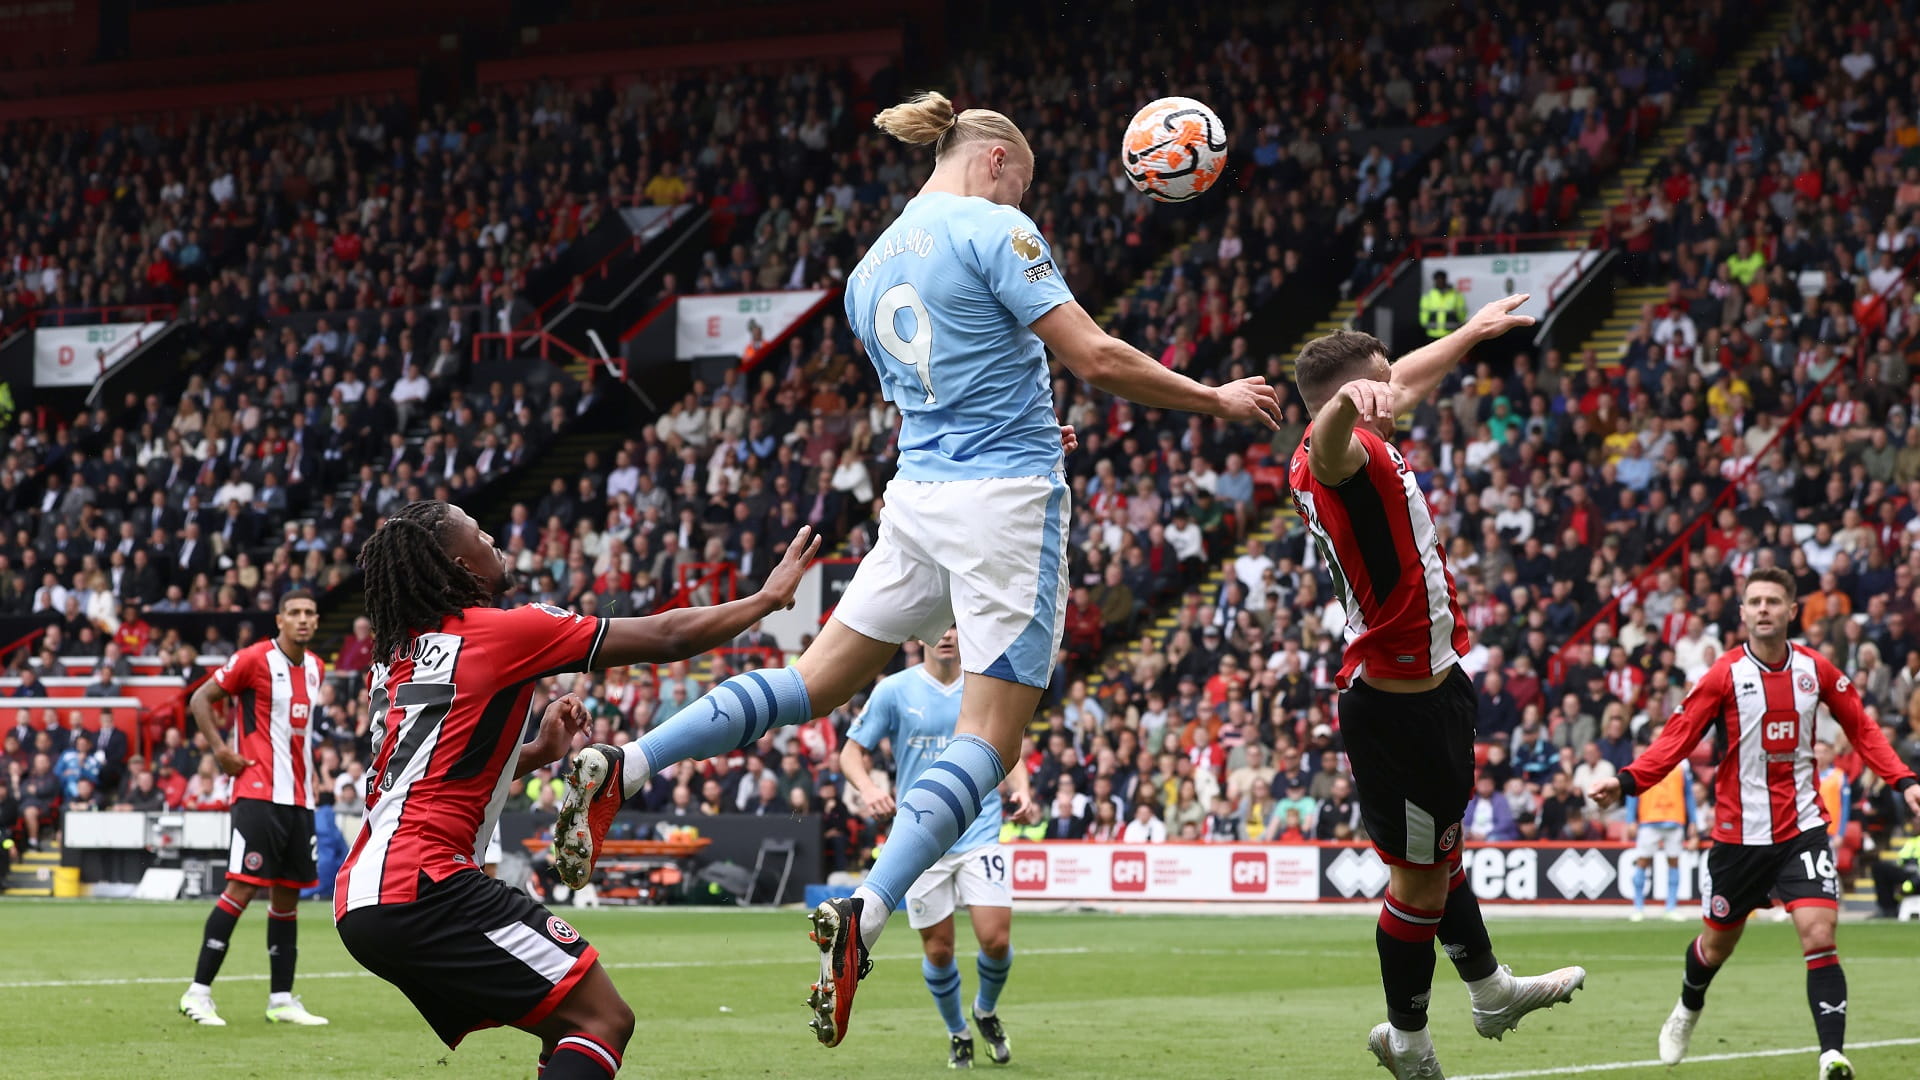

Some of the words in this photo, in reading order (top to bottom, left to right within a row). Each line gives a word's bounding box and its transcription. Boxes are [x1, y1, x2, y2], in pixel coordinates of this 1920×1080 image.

[856, 227, 934, 287] HAALAND
[706, 315, 722, 338] E
[58, 345, 75, 366] D
[874, 282, 936, 405] 9
[1766, 721, 1795, 740] CFI
[980, 855, 1004, 881] 19
[1800, 849, 1838, 880] 16
